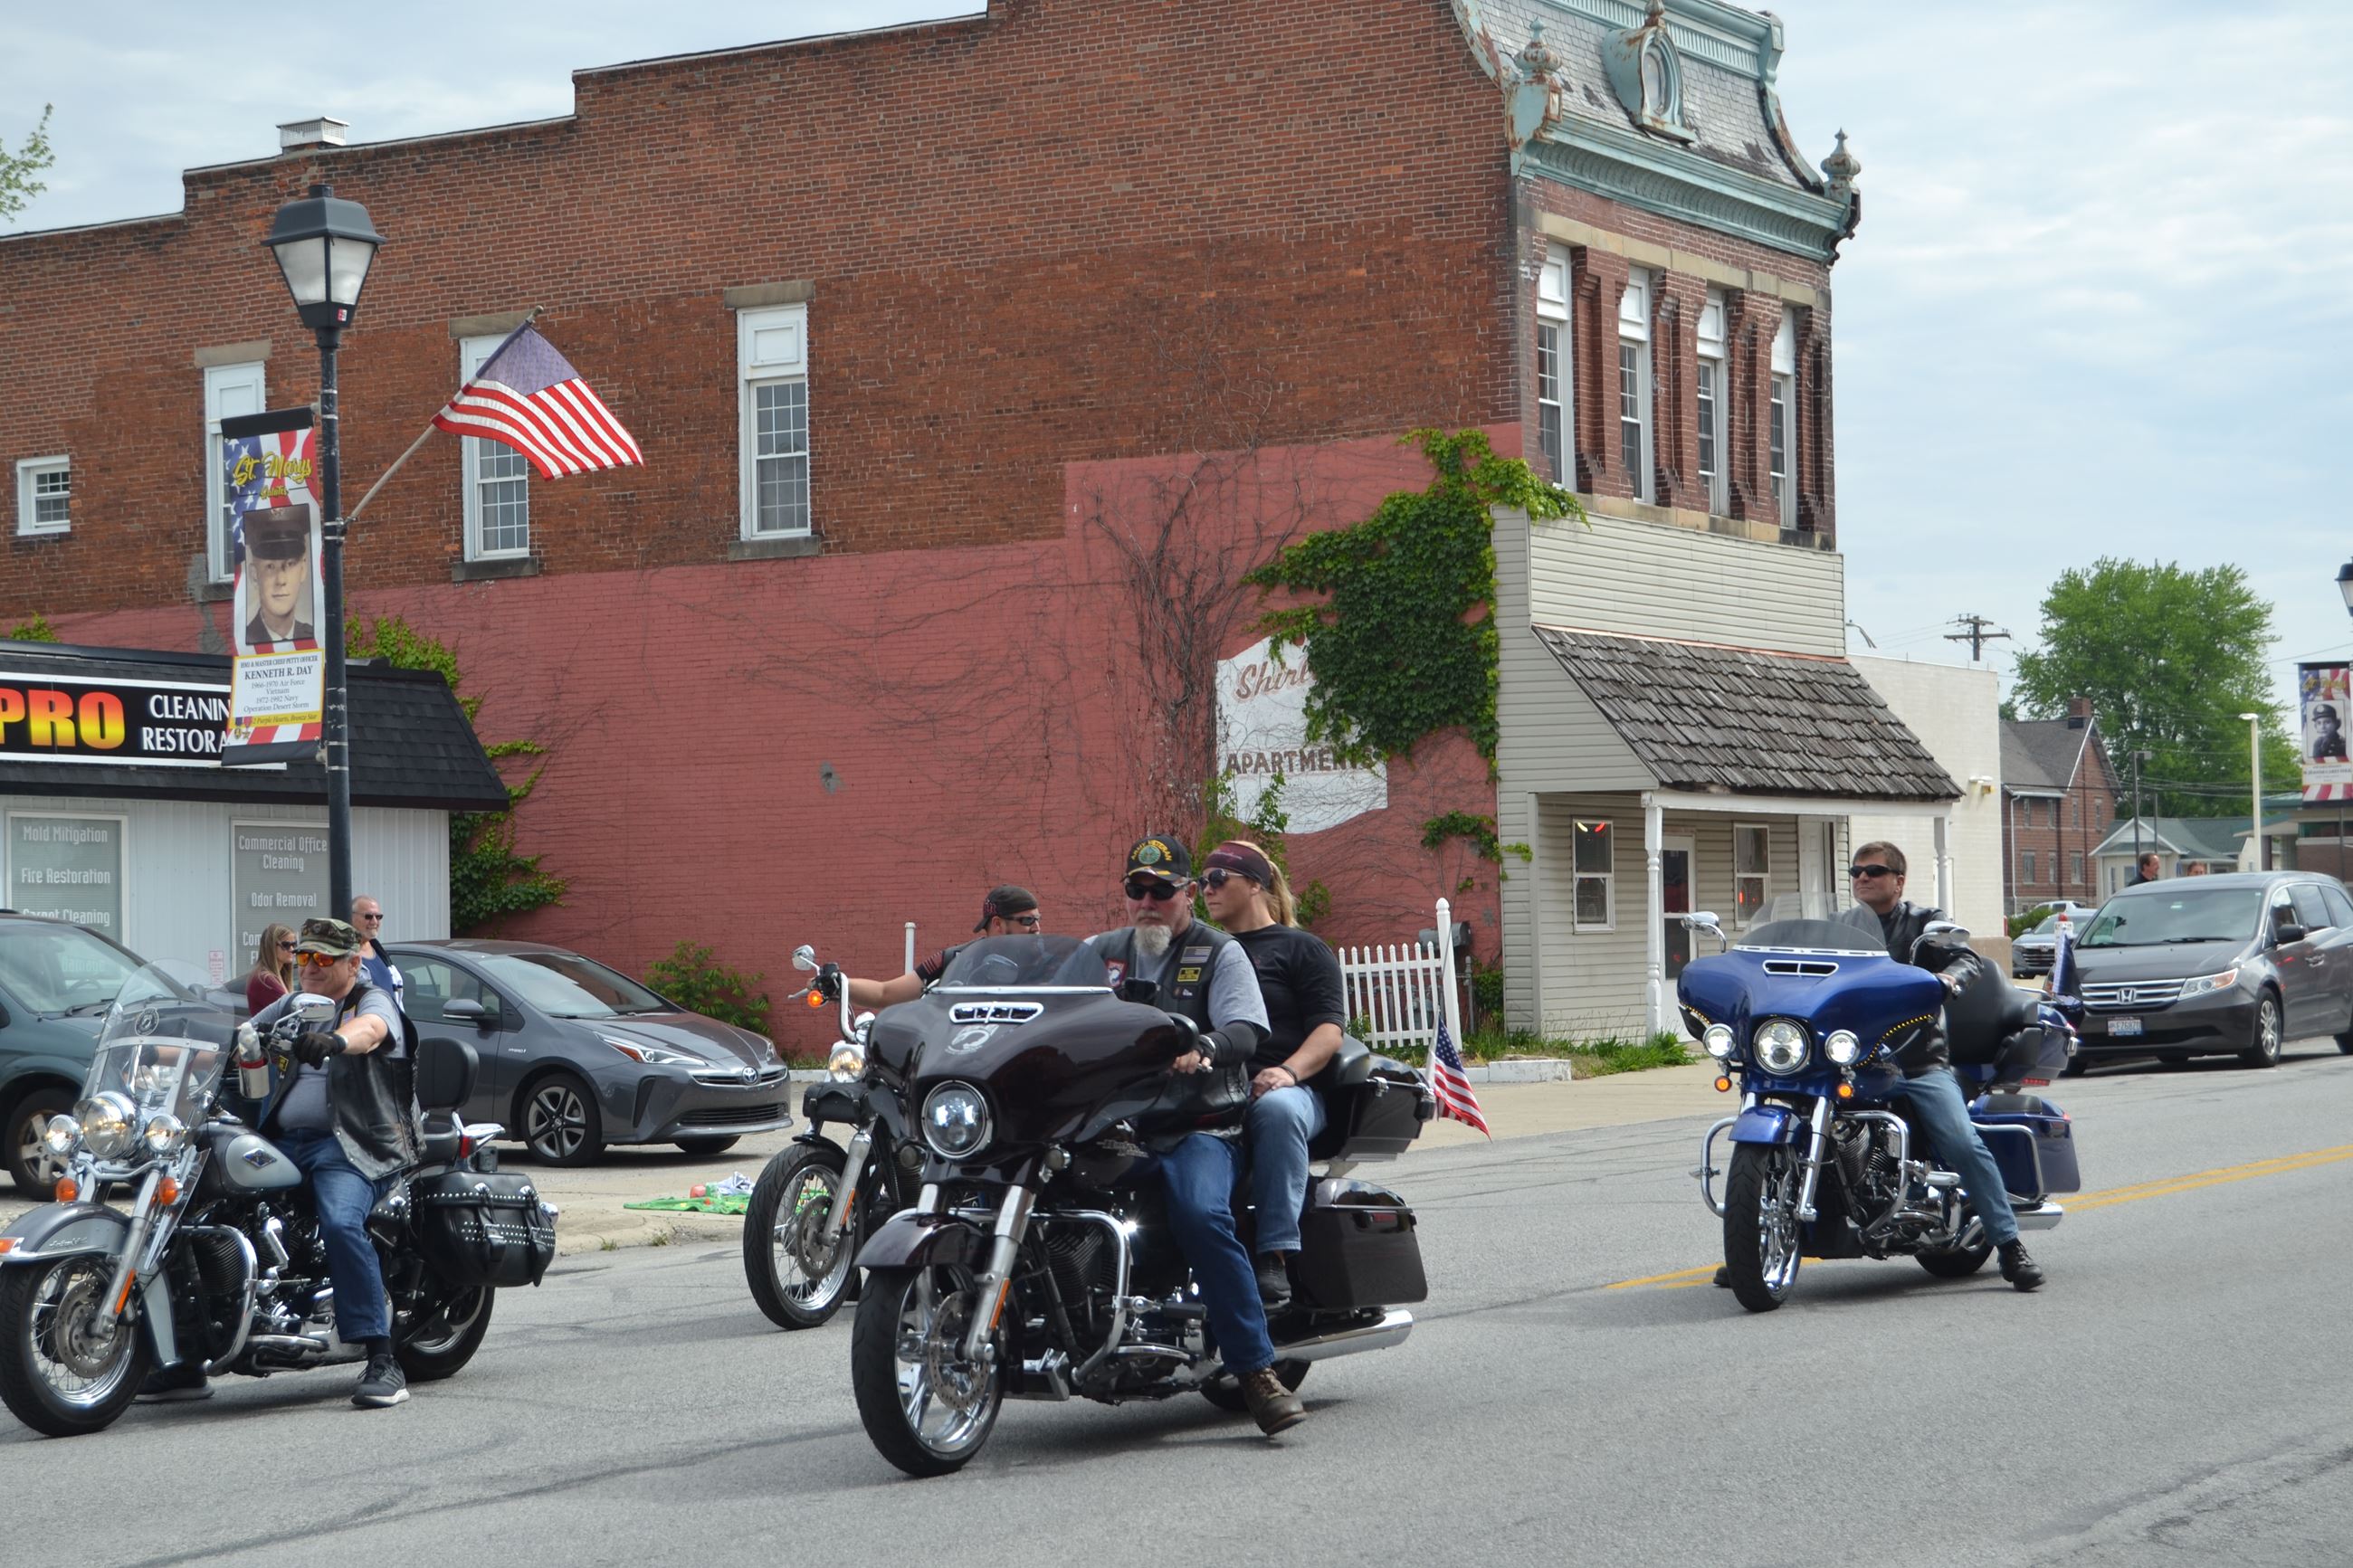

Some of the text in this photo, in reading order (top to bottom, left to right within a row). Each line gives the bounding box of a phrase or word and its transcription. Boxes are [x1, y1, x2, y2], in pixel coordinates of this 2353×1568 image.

[254, 660, 272, 668] MASTER
[286, 657, 300, 665] PETTY
[244, 665, 313, 679] KENNETH R. DAY
[1235, 660, 1309, 699] Shirl
[266, 687, 290, 695] Vietnam
[149, 694, 231, 721] CLEANIN
[243, 701, 310, 714] Operation Desert Storm
[142, 727, 226, 753] RESTORA
[23, 826, 109, 845] Mold Mitigation
[239, 835, 328, 853] Commercial Office
[1147, 840, 1173, 861] VETERAN
[262, 854, 304, 872] Cleaning
[22, 868, 110, 884] Fire Restoration
[252, 892, 317, 908] Odor Removal
